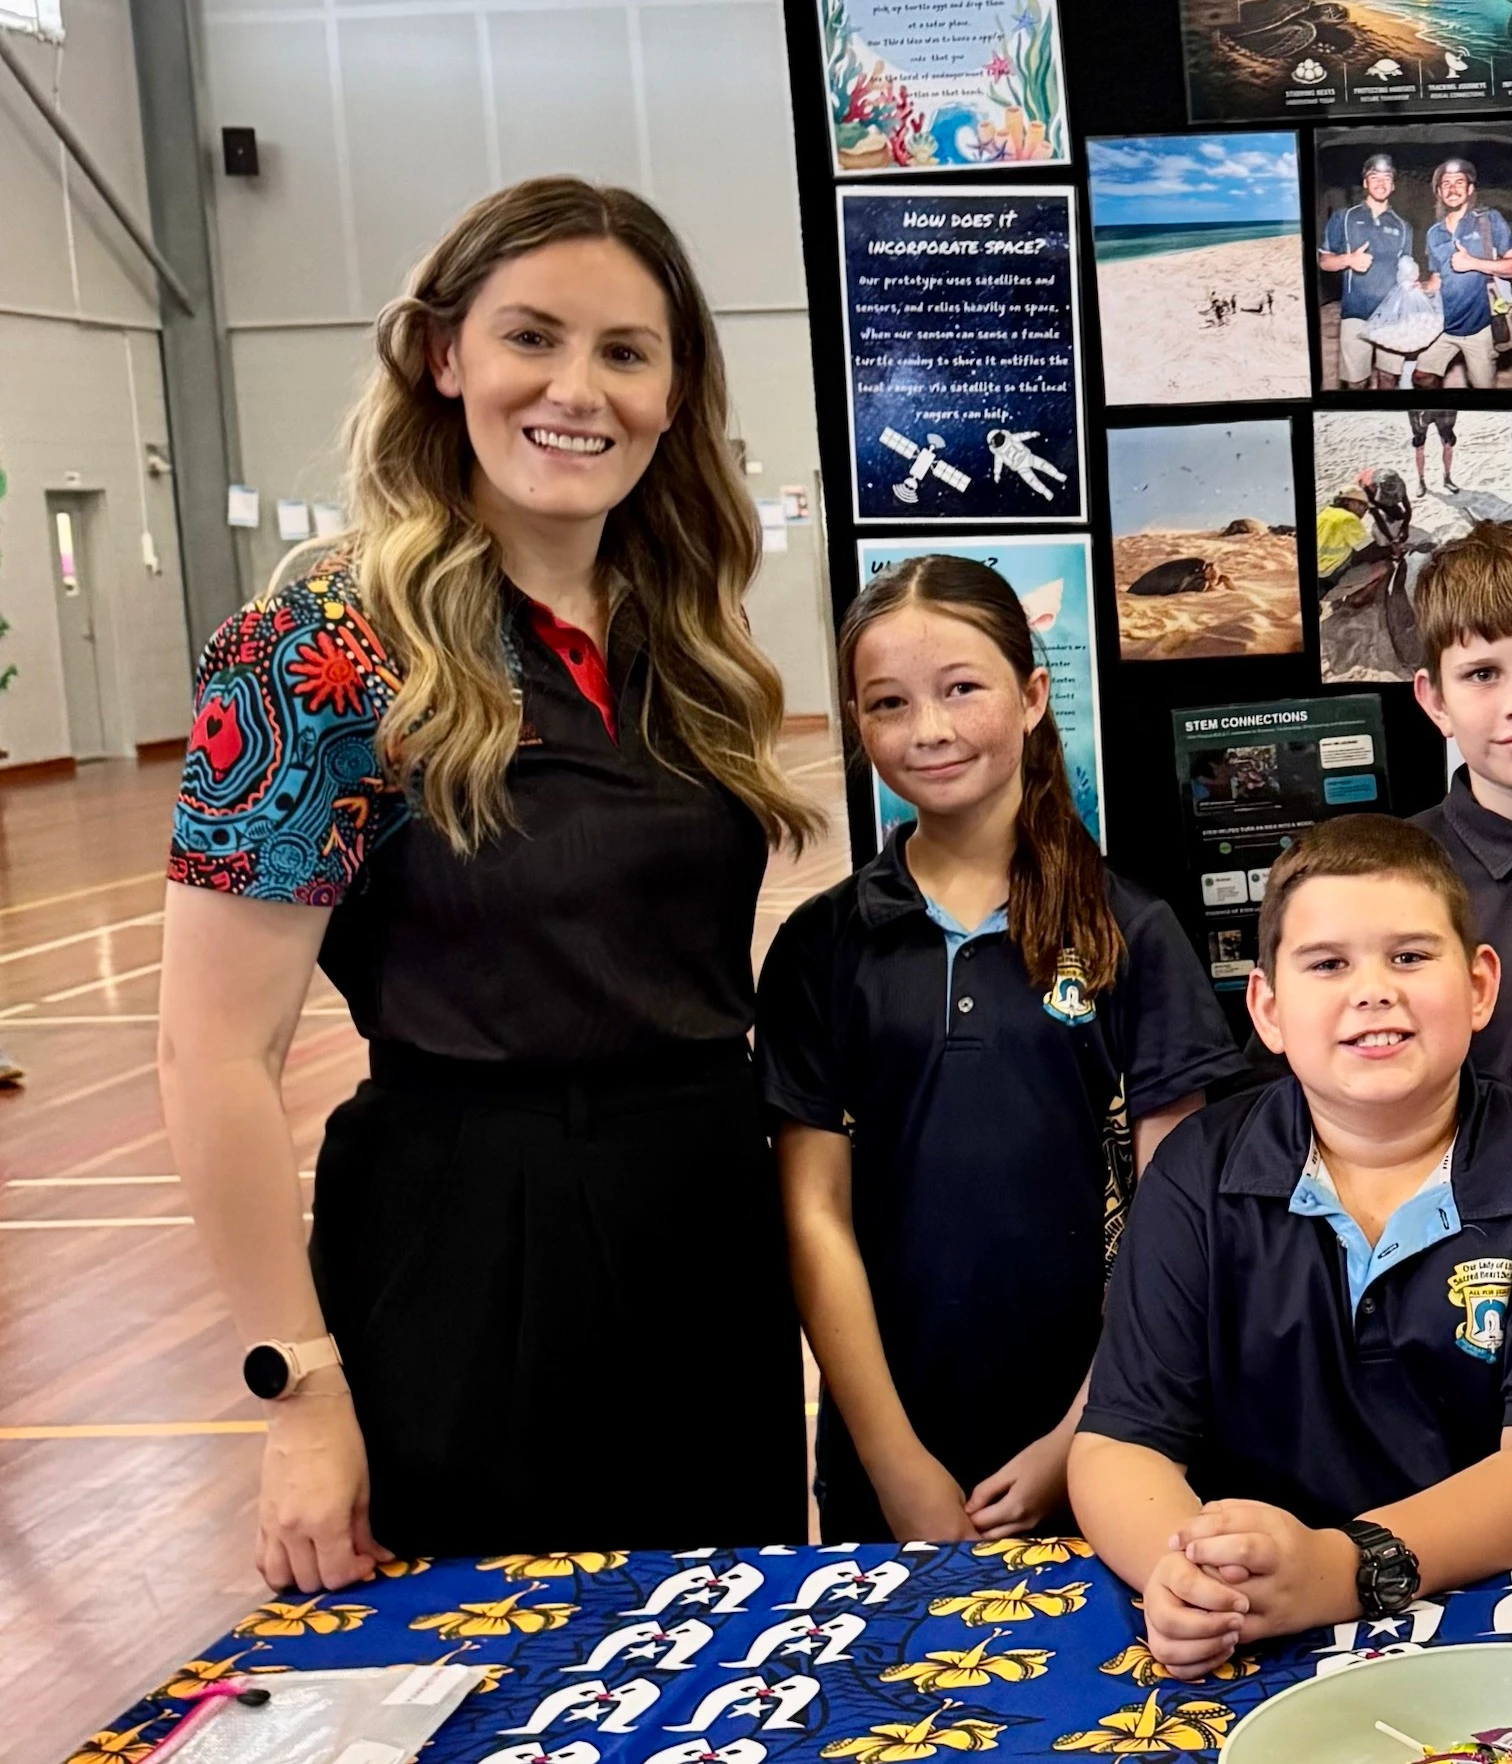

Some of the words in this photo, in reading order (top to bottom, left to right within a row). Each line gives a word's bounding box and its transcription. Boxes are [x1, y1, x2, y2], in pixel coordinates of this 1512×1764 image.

[858, 276, 881, 287] Our
[884, 275, 943, 291] prototype
[946, 277, 972, 287] uses
[975, 274, 1032, 287] satellites
[1035, 275, 1056, 287] and
[855, 302, 901, 315] sensors,
[904, 301, 924, 314] and
[927, 302, 961, 314] relies
[963, 300, 1006, 317] heavily
[1009, 303, 1021, 314] on
[1024, 302, 1060, 317] space.
[860, 327, 891, 340] When
[893, 331, 913, 340] our
[956, 331, 975, 340] can
[977, 331, 1008, 340] sense
[1010, 331, 1019, 340] a
[1021, 328, 1060, 340] female
[855, 355, 894, 367] turtle
[936, 355, 950, 367] to
[952, 355, 982, 366] shore
[984, 355, 997, 366] it
[1000, 354, 1046, 367] notifies
[1049, 355, 1069, 367] the
[857, 381, 885, 393] local
[929, 381, 947, 393] via
[950, 381, 1001, 394] satellite
[1004, 384, 1016, 393] so
[1018, 381, 1038, 393] the
[1041, 381, 1067, 393] local
[914, 409, 960, 424] rangers
[962, 411, 982, 420] can
[983, 408, 1014, 424] help.
[1185, 718, 1219, 733] STEM
[1220, 710, 1309, 729] CONNECTIONS
[1462, 1264, 1477, 1272] Our
[1478, 1261, 1494, 1270] Lady
[1495, 1261, 1504, 1269] of
